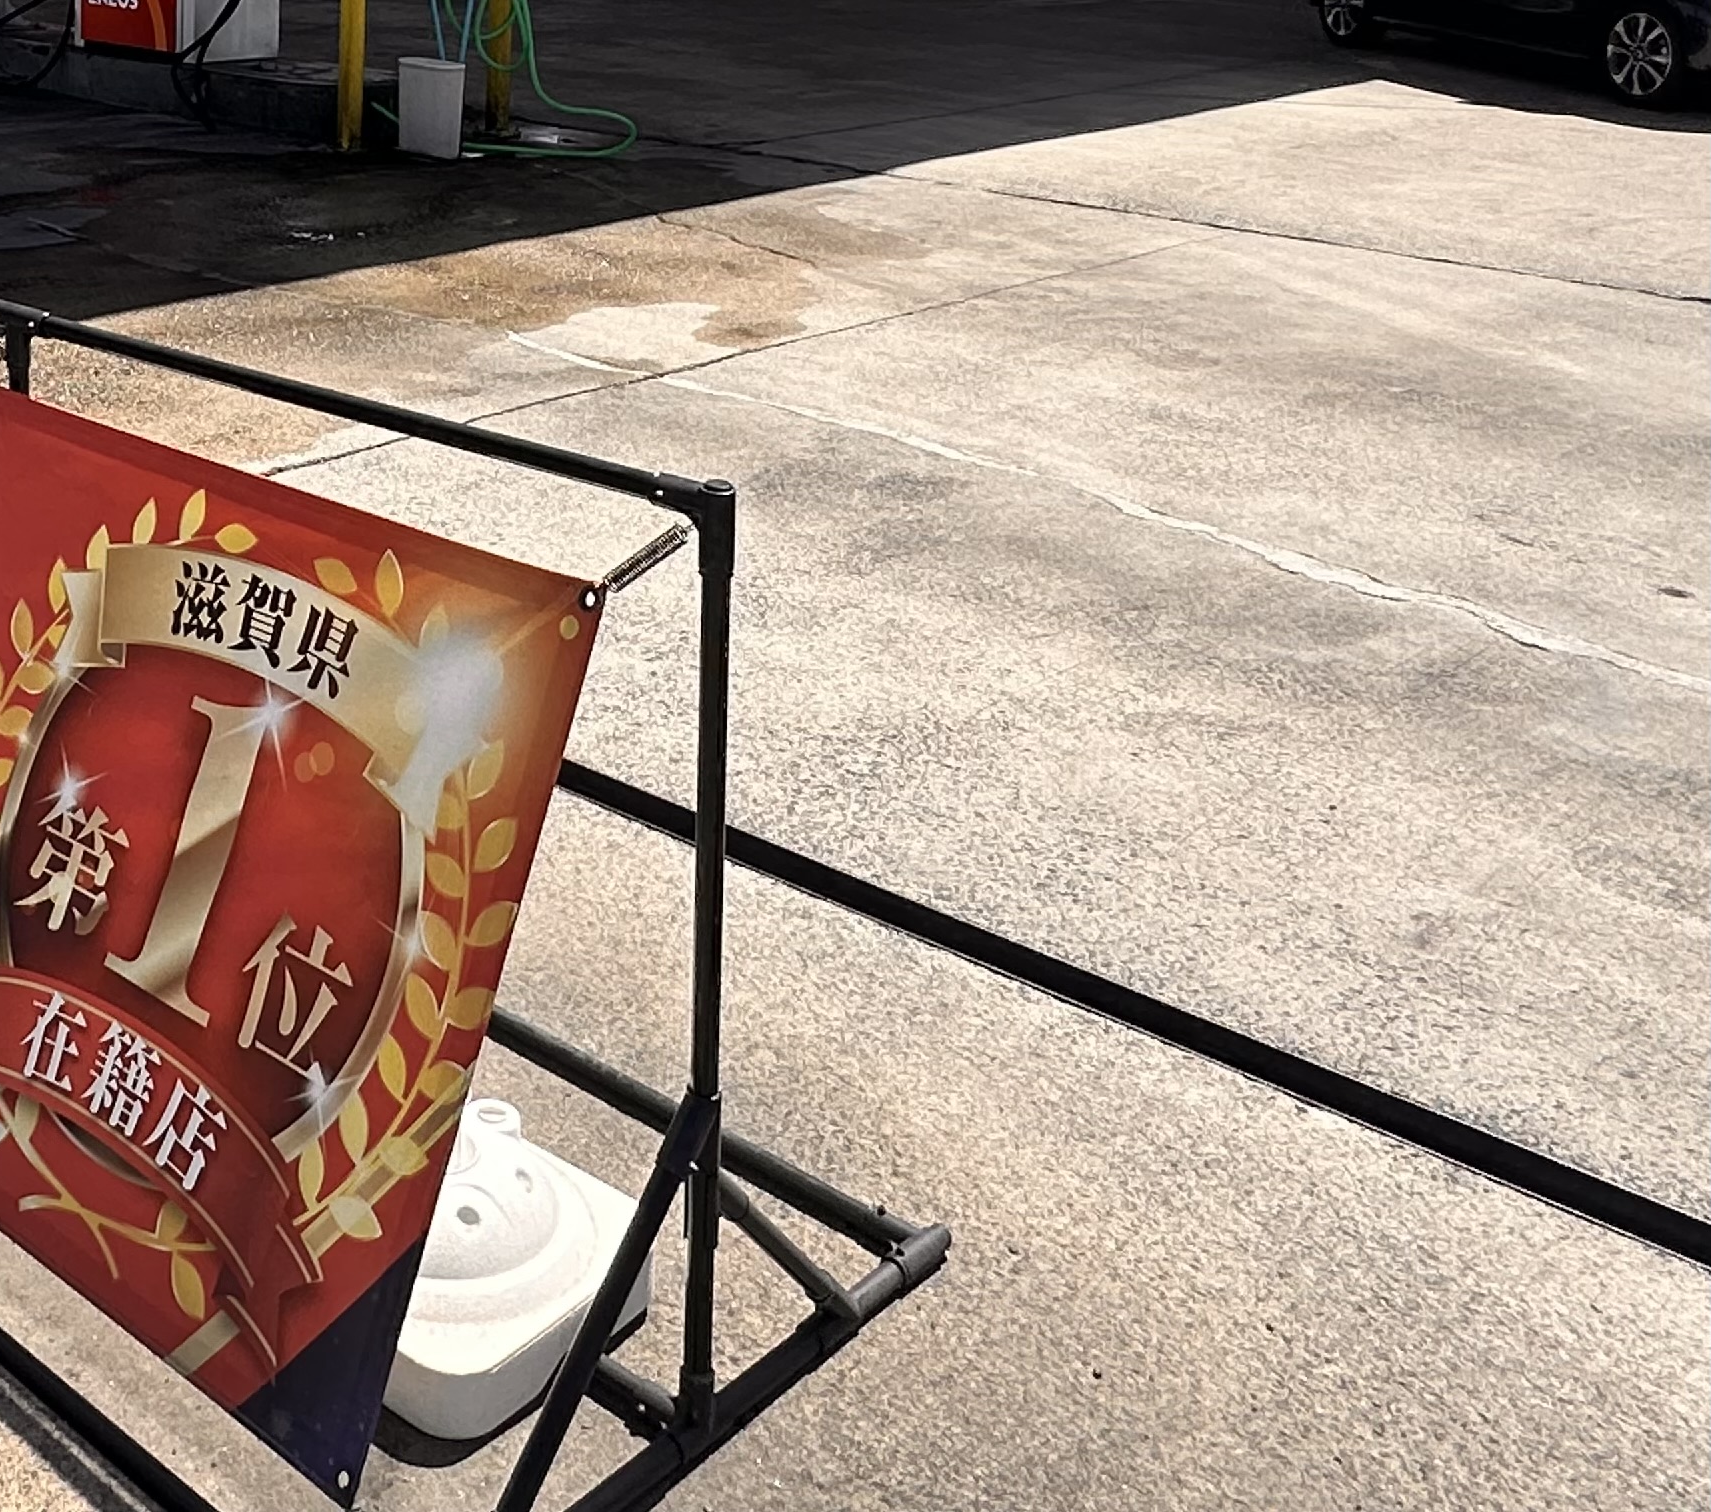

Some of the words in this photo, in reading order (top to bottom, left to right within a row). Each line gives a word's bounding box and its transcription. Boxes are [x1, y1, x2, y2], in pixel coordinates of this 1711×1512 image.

[169, 560, 360, 700] 滋賀県
[20, 991, 228, 1191] 在籍店
